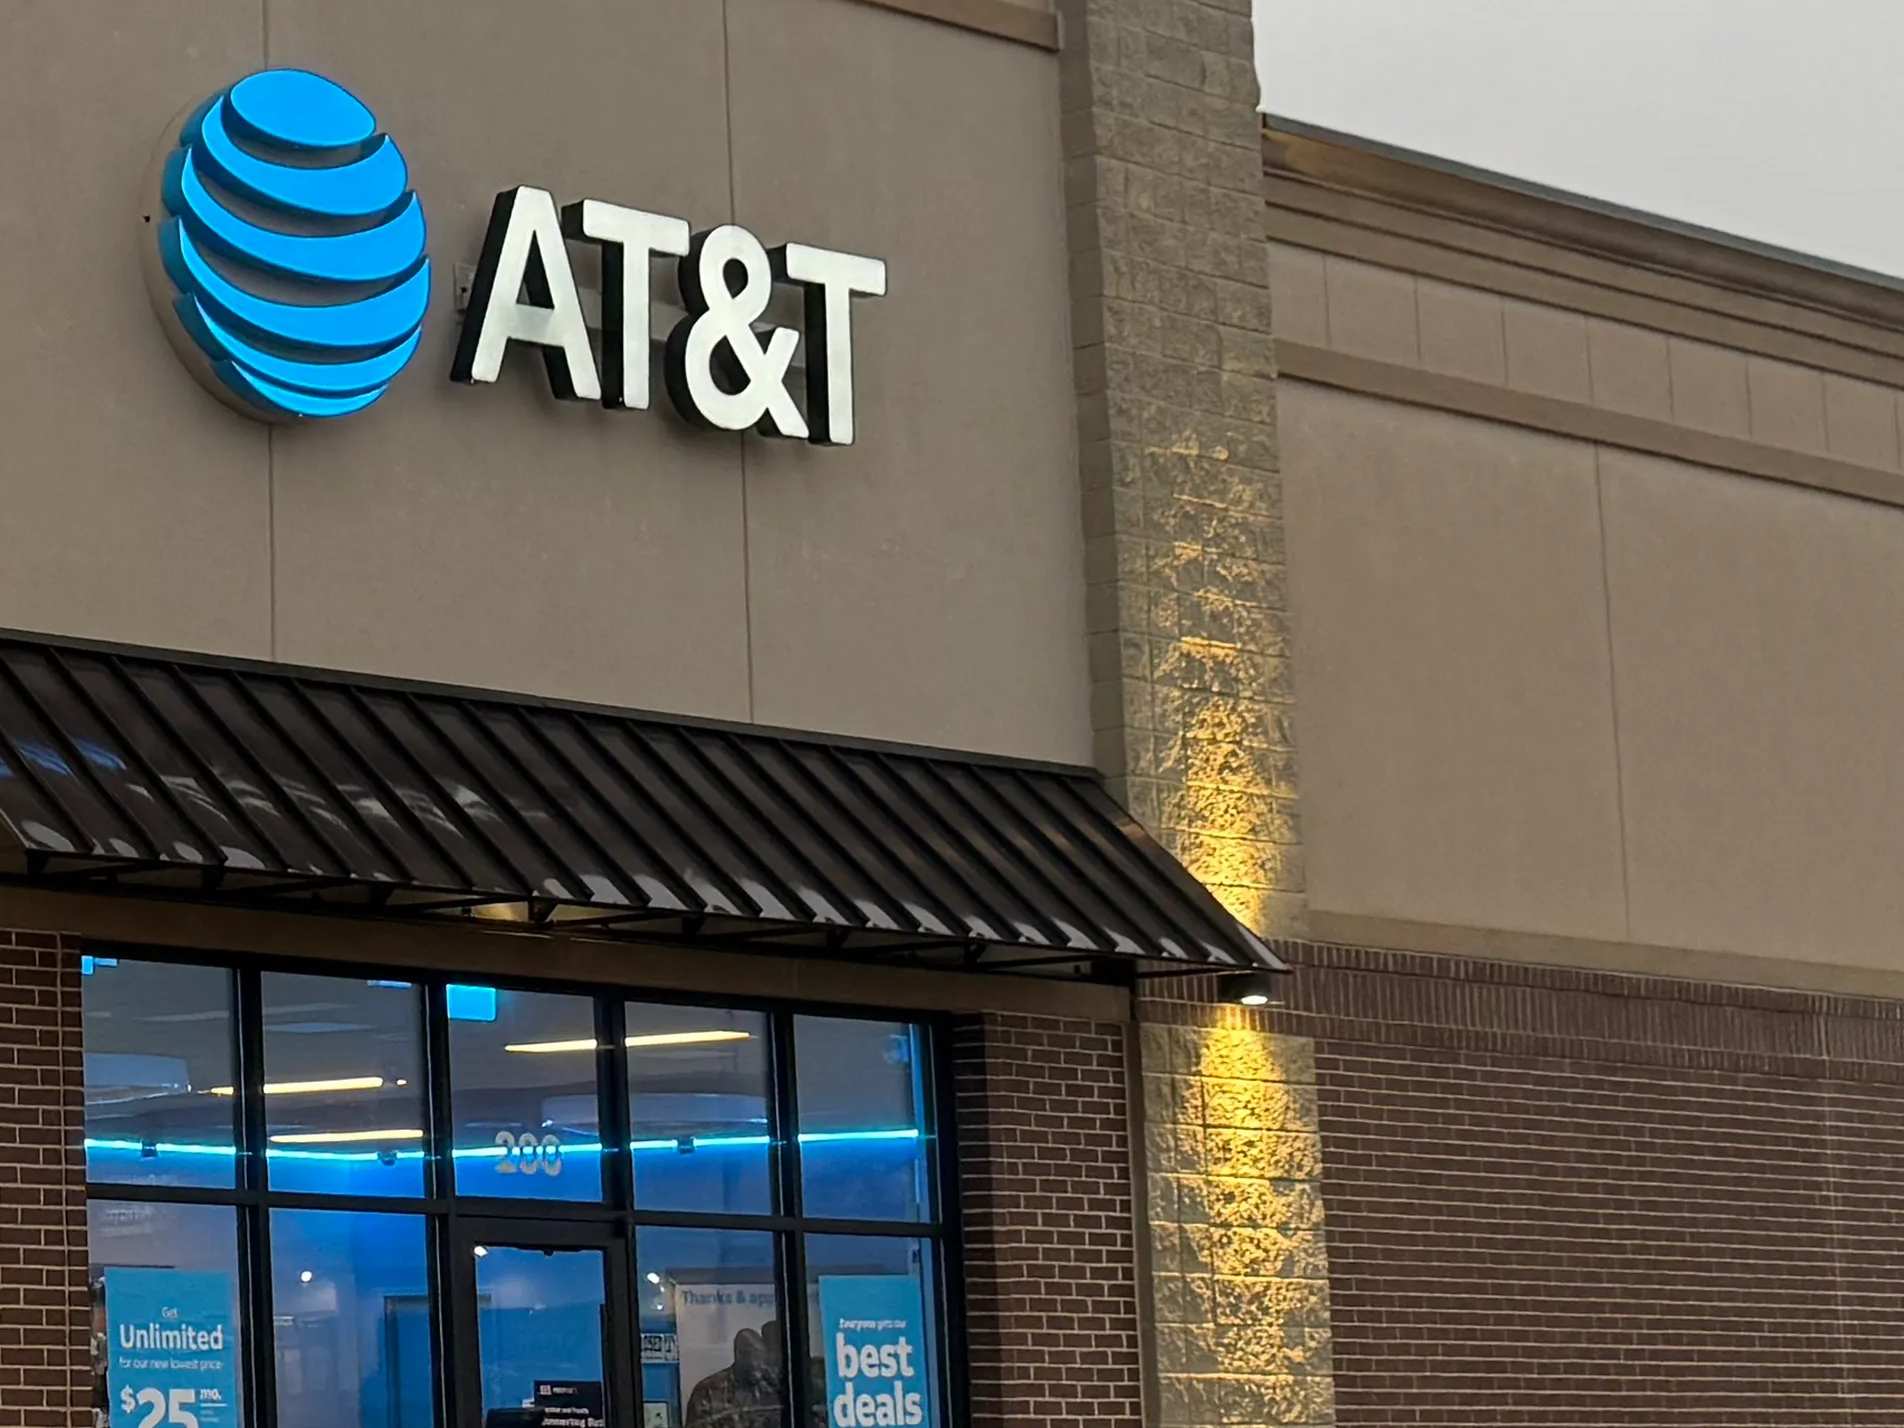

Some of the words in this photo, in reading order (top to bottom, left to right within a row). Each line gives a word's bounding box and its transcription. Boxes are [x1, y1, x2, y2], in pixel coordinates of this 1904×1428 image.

[468, 184, 887, 446] AT&T
[494, 1130, 562, 1176] 200
[161, 1306, 179, 1319] Get
[683, 1288, 731, 1306] Thanks
[119, 1323, 224, 1351] Unlimited
[835, 1332, 915, 1379] best
[833, 1380, 923, 1428] deals
